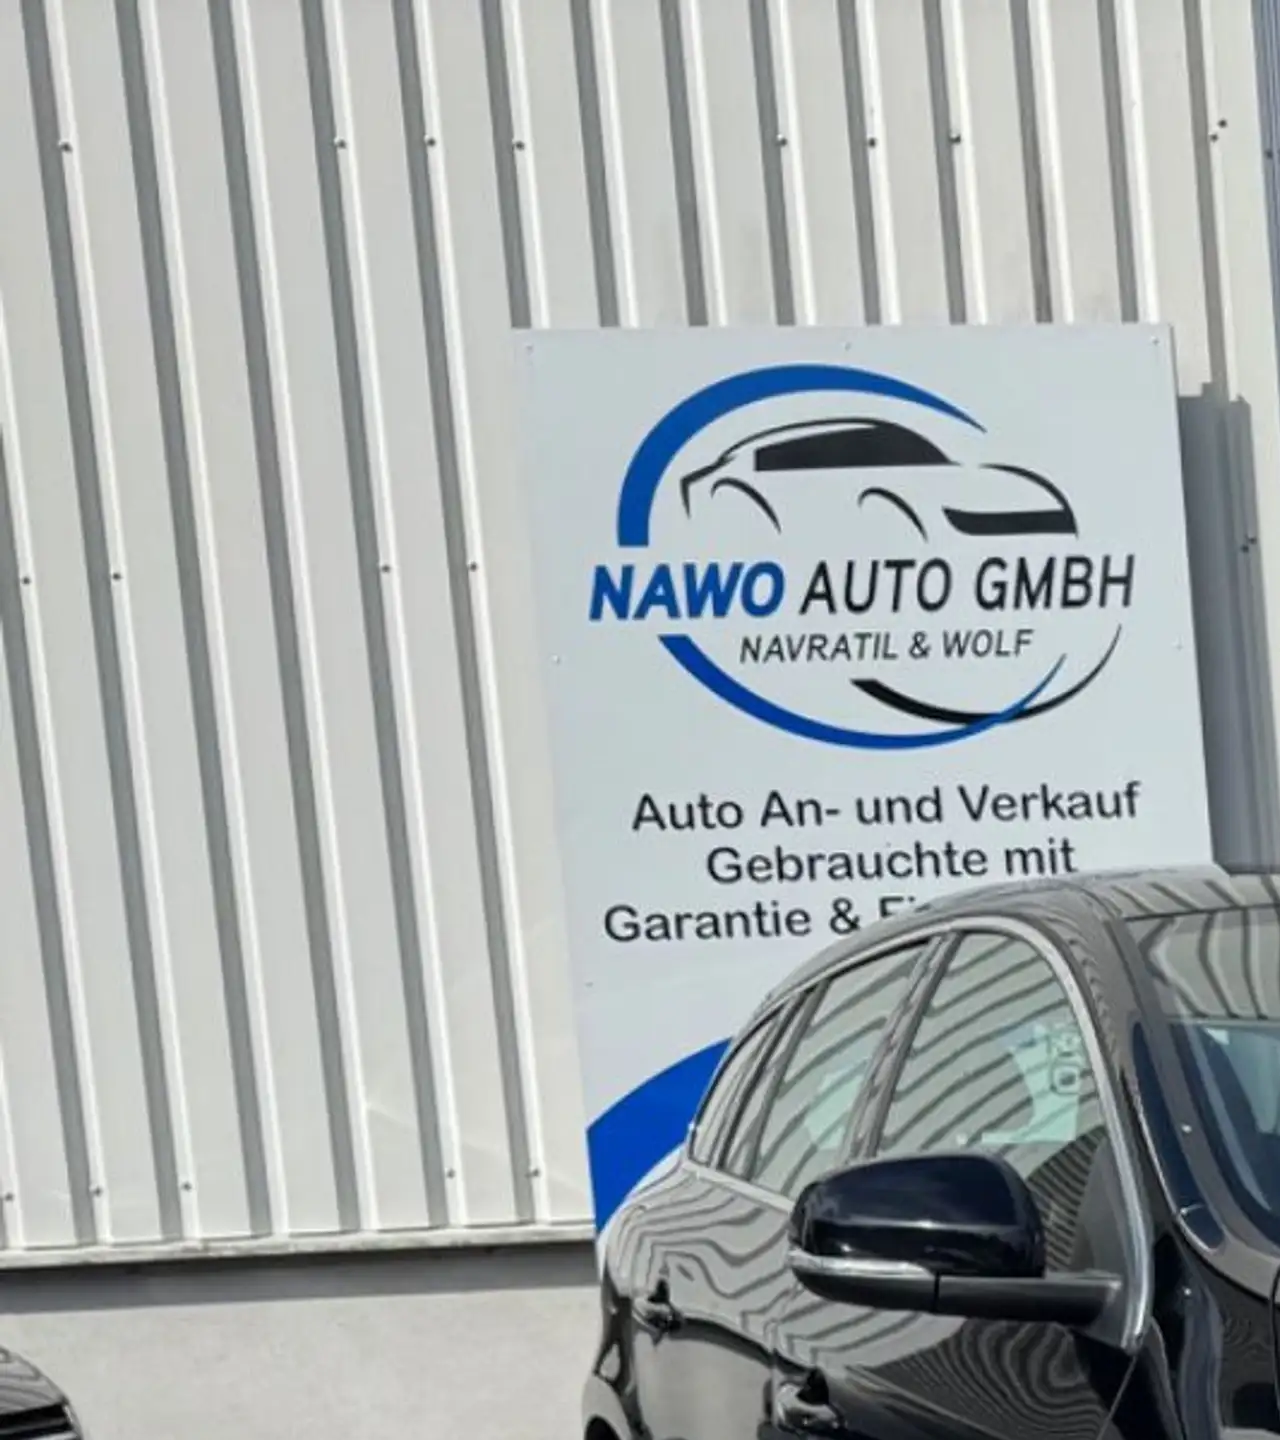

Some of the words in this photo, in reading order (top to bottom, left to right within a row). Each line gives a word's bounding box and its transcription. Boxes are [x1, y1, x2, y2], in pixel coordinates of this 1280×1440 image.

[588, 561, 785, 621] NAWO
[799, 557, 952, 615] AUTO
[974, 553, 1135, 611] GMBH
[739, 632, 898, 663] NAVRATIL
[908, 630, 931, 660] &
[943, 628, 1034, 658] WOLF
[631, 792, 744, 831] Auto
[760, 788, 840, 828] An-
[855, 785, 943, 824] und
[957, 780, 1141, 822] Verkauf
[706, 841, 989, 884] Gebrauchte
[1004, 837, 1077, 876] mit
[603, 900, 812, 943] Garantie
[829, 897, 861, 935] &
